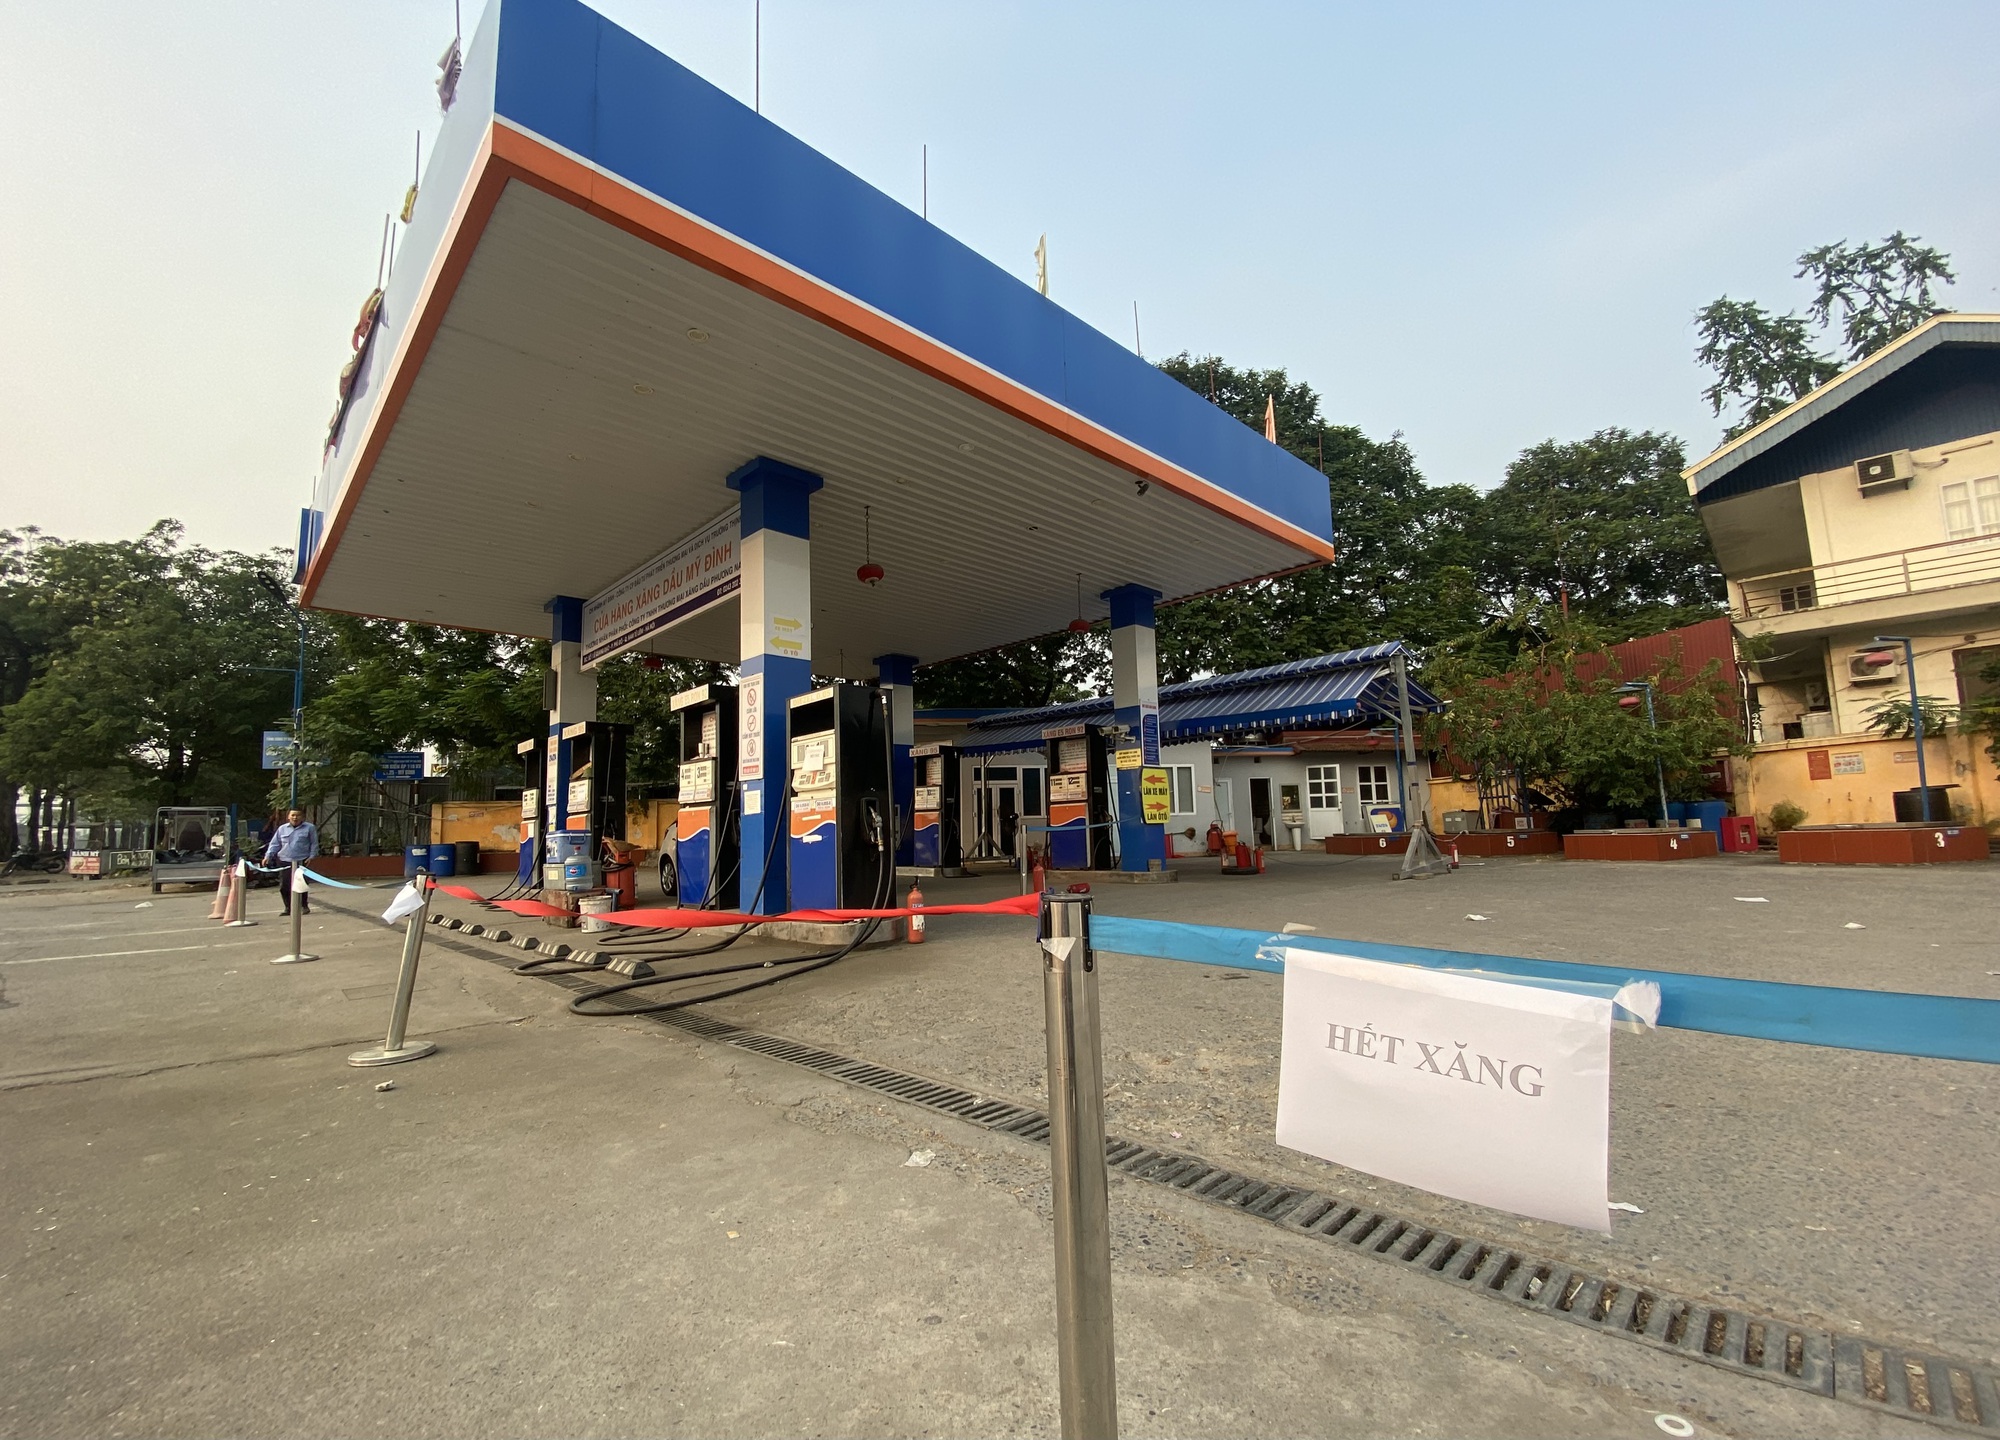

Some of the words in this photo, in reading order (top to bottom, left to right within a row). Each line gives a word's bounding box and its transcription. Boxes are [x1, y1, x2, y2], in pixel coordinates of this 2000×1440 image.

[729, 516, 740, 529] THỊN
[594, 611, 608, 633] CỬA
[611, 598, 632, 624] HÀNG
[635, 583, 659, 610] XĂNG
[662, 568, 682, 596] DẦU
[685, 556, 700, 583] MỸ
[704, 541, 731, 572] ĐÌNH
[685, 585, 698, 598] XĂNG
[699, 577, 709, 590] DẦU
[710, 566, 732, 584] PHƯƠNG
[1065, 727, 1076, 735] RON
[1159, 786, 1167, 795] MÁY
[1379, 838, 1386, 847] 6
[1507, 835, 1515, 847] 5
[1670, 838, 1678, 849] 4
[1934, 832, 1945, 847] 3
[1325, 1022, 1404, 1064] HẾT
[1414, 1040, 1545, 1098] XĂNG
